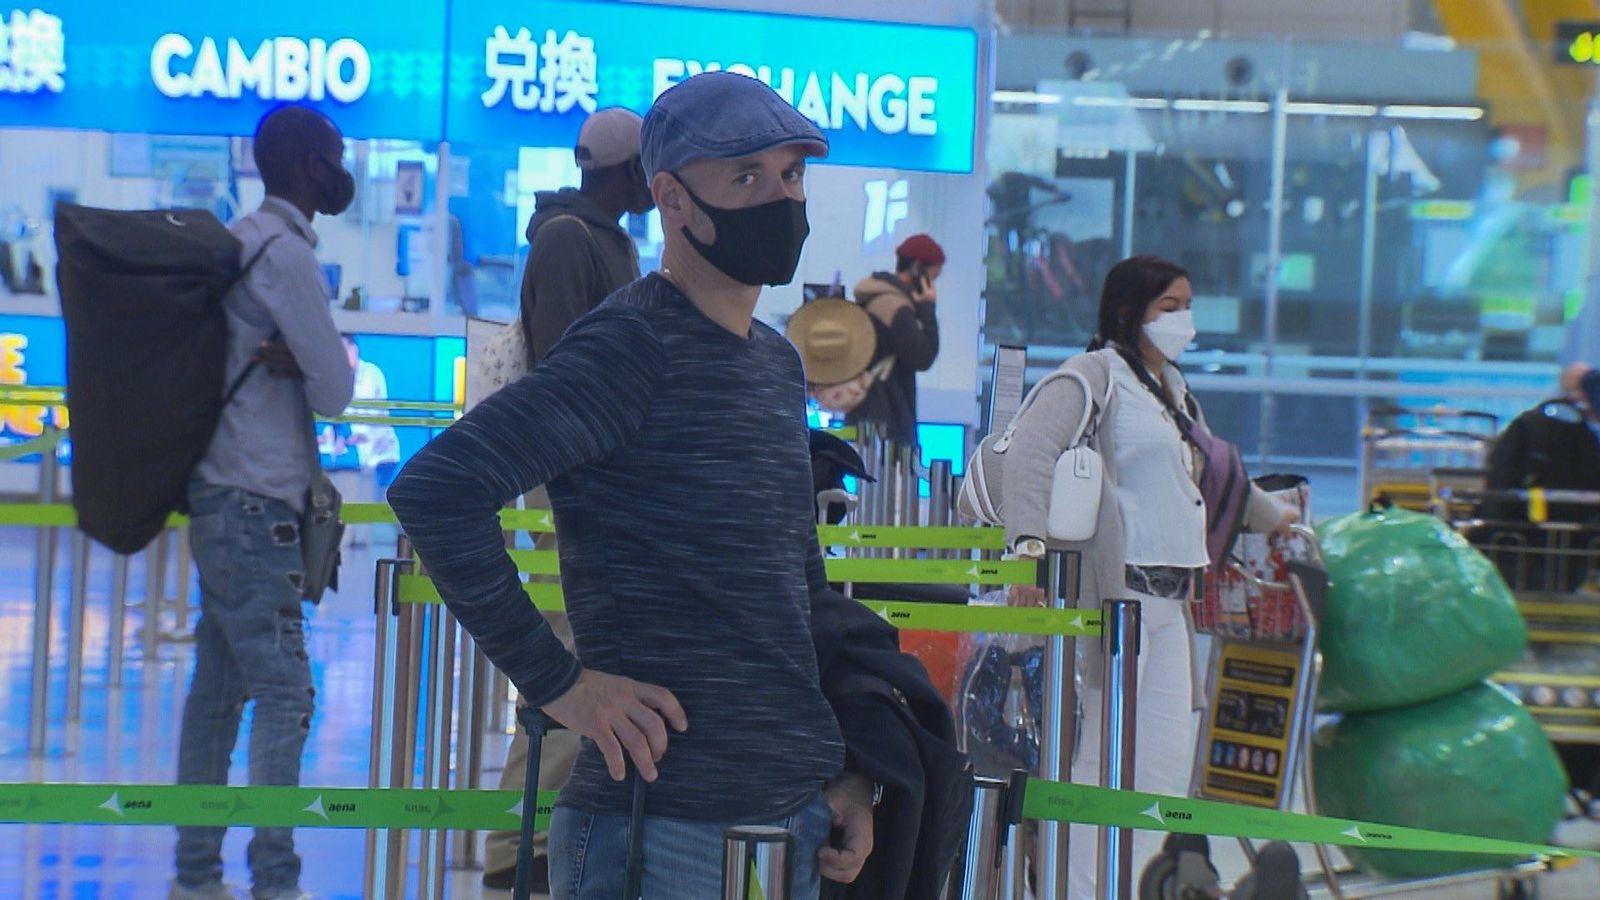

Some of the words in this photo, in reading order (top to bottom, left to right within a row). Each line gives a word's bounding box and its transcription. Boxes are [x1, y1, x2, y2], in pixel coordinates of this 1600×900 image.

[150, 33, 371, 103] CAMBIO
[652, 58, 938, 136] EANGE
[327, 802, 356, 813] aena
[1164, 809, 1193, 820] aena
